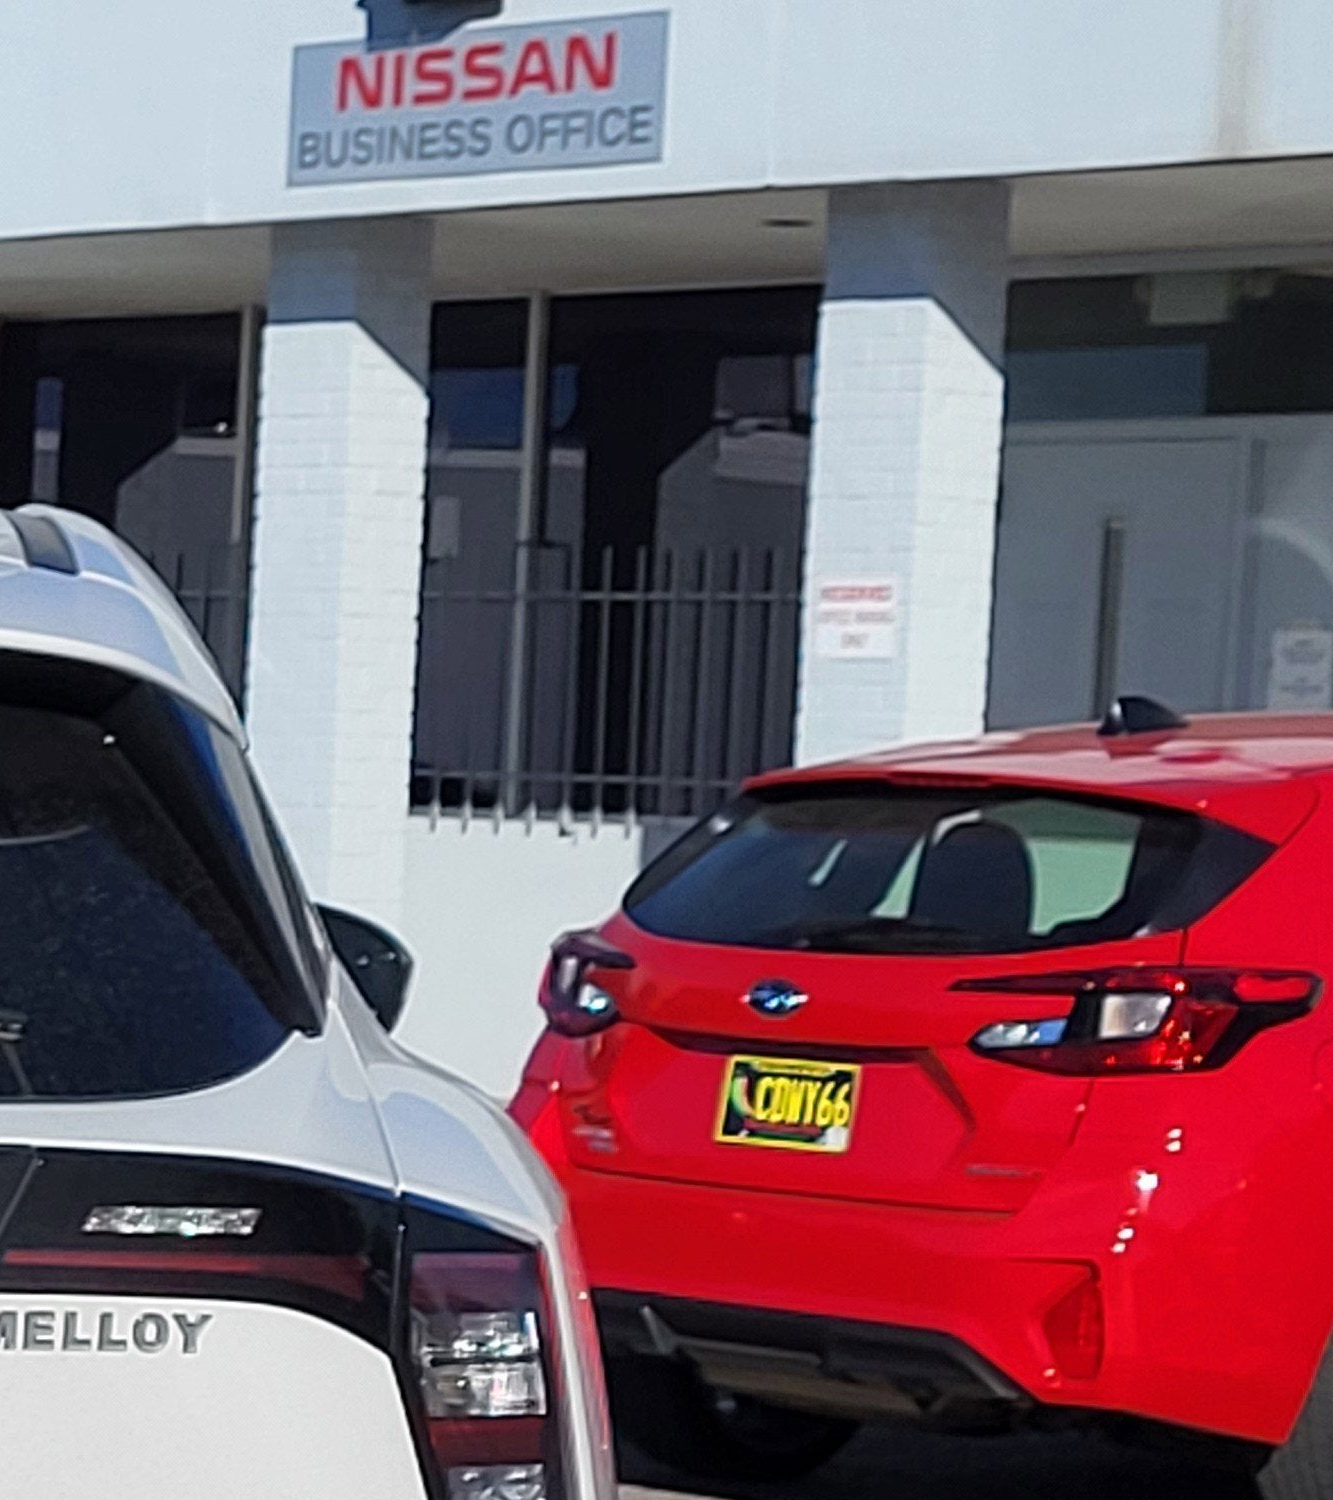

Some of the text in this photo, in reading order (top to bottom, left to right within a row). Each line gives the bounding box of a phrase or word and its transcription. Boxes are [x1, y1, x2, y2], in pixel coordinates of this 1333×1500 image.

[338, 31, 619, 111] NISSAN
[297, 105, 654, 170] BUSINESS OFFICE
